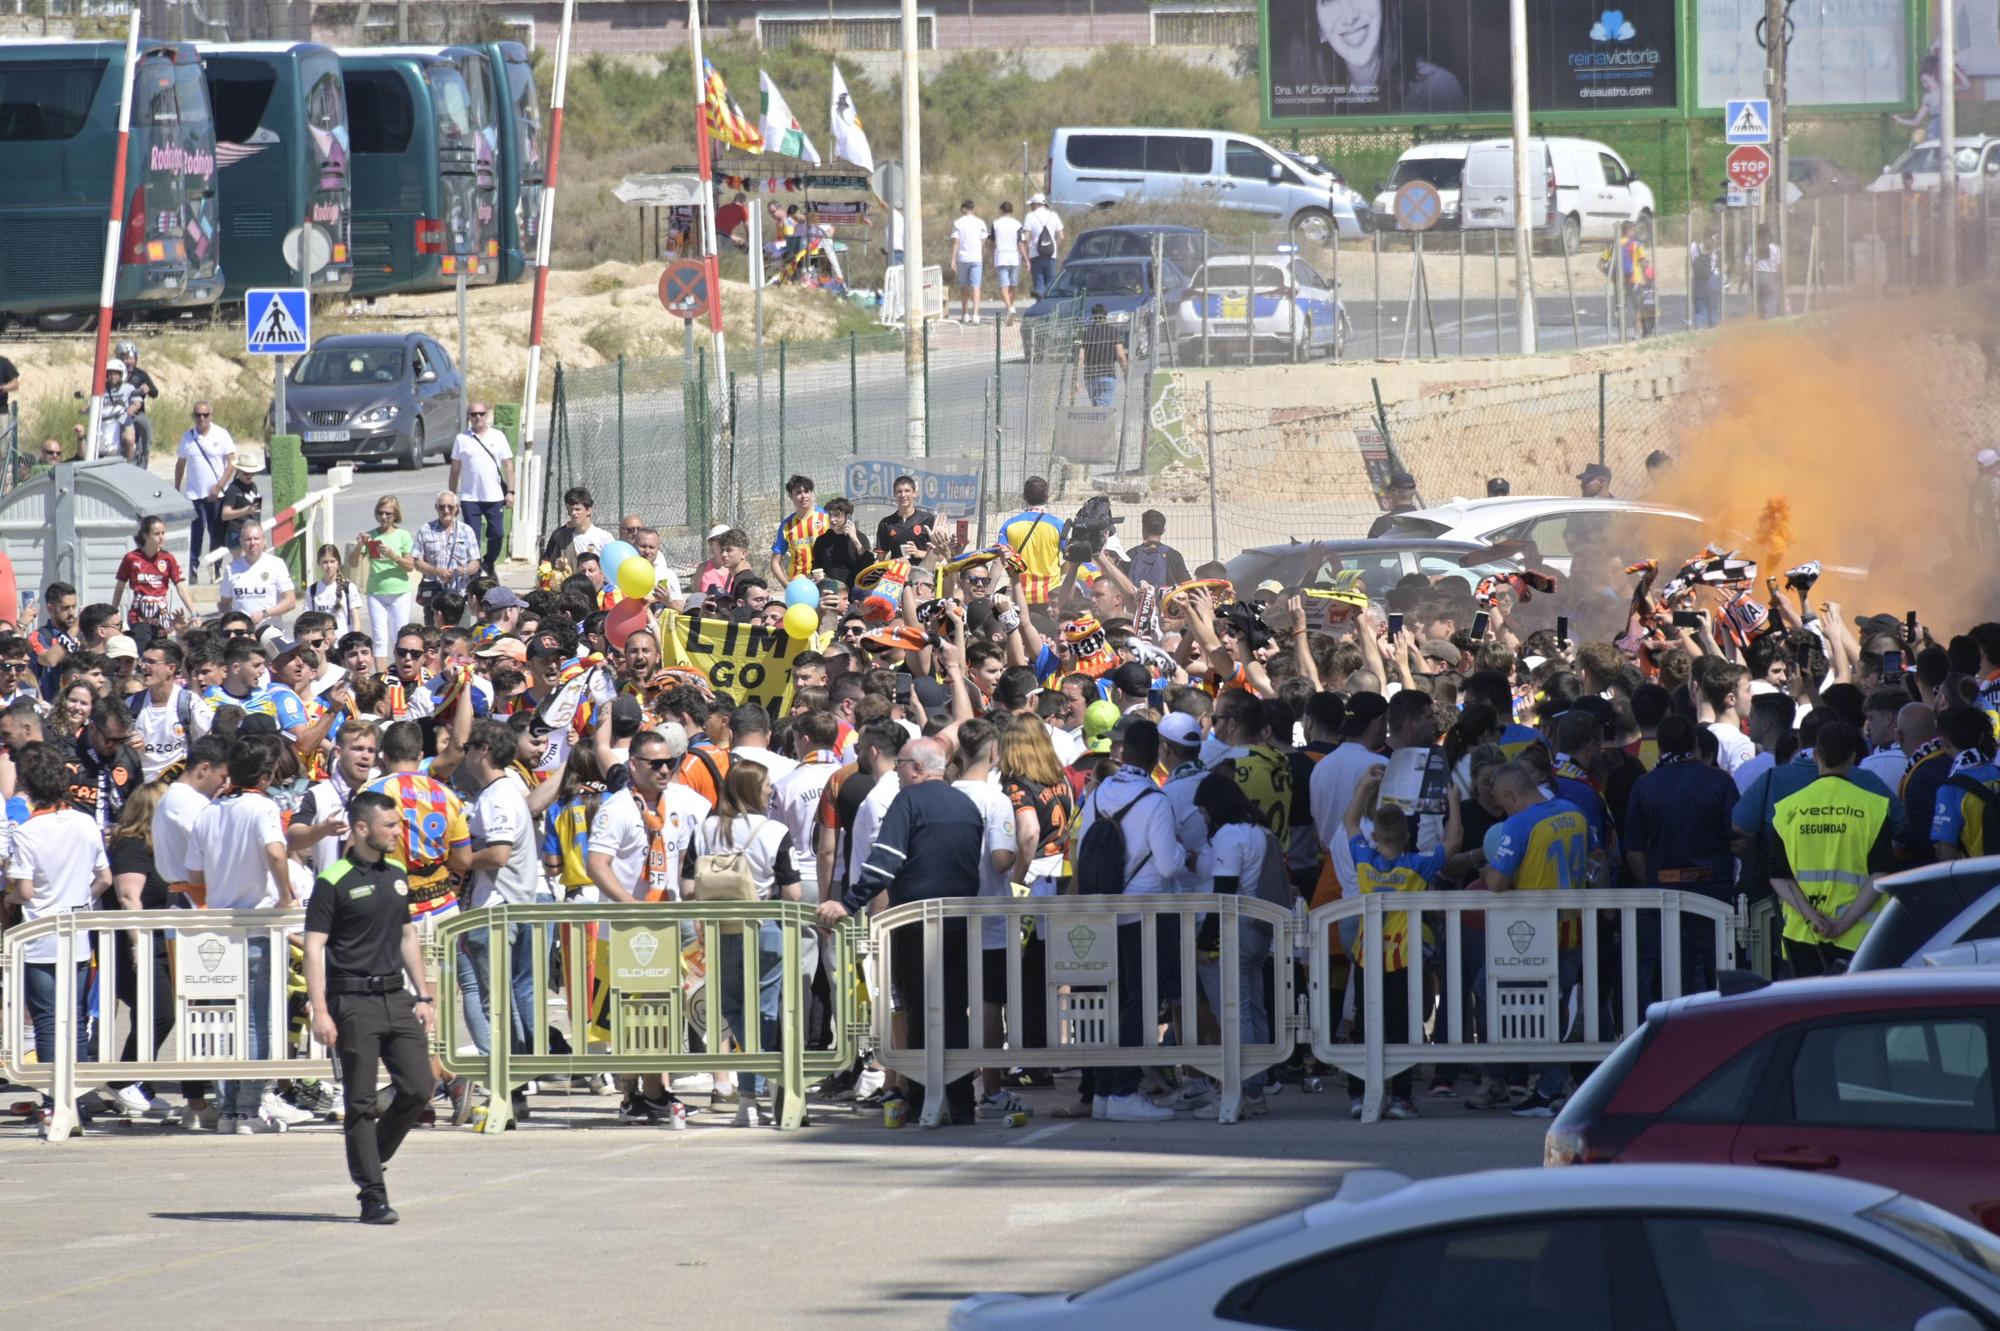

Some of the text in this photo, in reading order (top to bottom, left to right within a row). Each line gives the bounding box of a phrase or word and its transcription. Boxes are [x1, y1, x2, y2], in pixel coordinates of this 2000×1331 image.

[1568, 49, 1659, 66] reinavictoria
[1274, 85, 1292, 96] Dra.
[1311, 83, 1345, 95] Dolores
[1348, 83, 1378, 94] Austro
[1579, 86, 1652, 97] draaustro.com
[1731, 161, 1766, 173] STOP
[313, 202, 339, 224] Rodrigo
[709, 661, 766, 690] GO
[1799, 806, 1865, 819] vectalia
[1799, 823, 1847, 835] SEGURIDAD
[1546, 831, 1586, 890] 14
